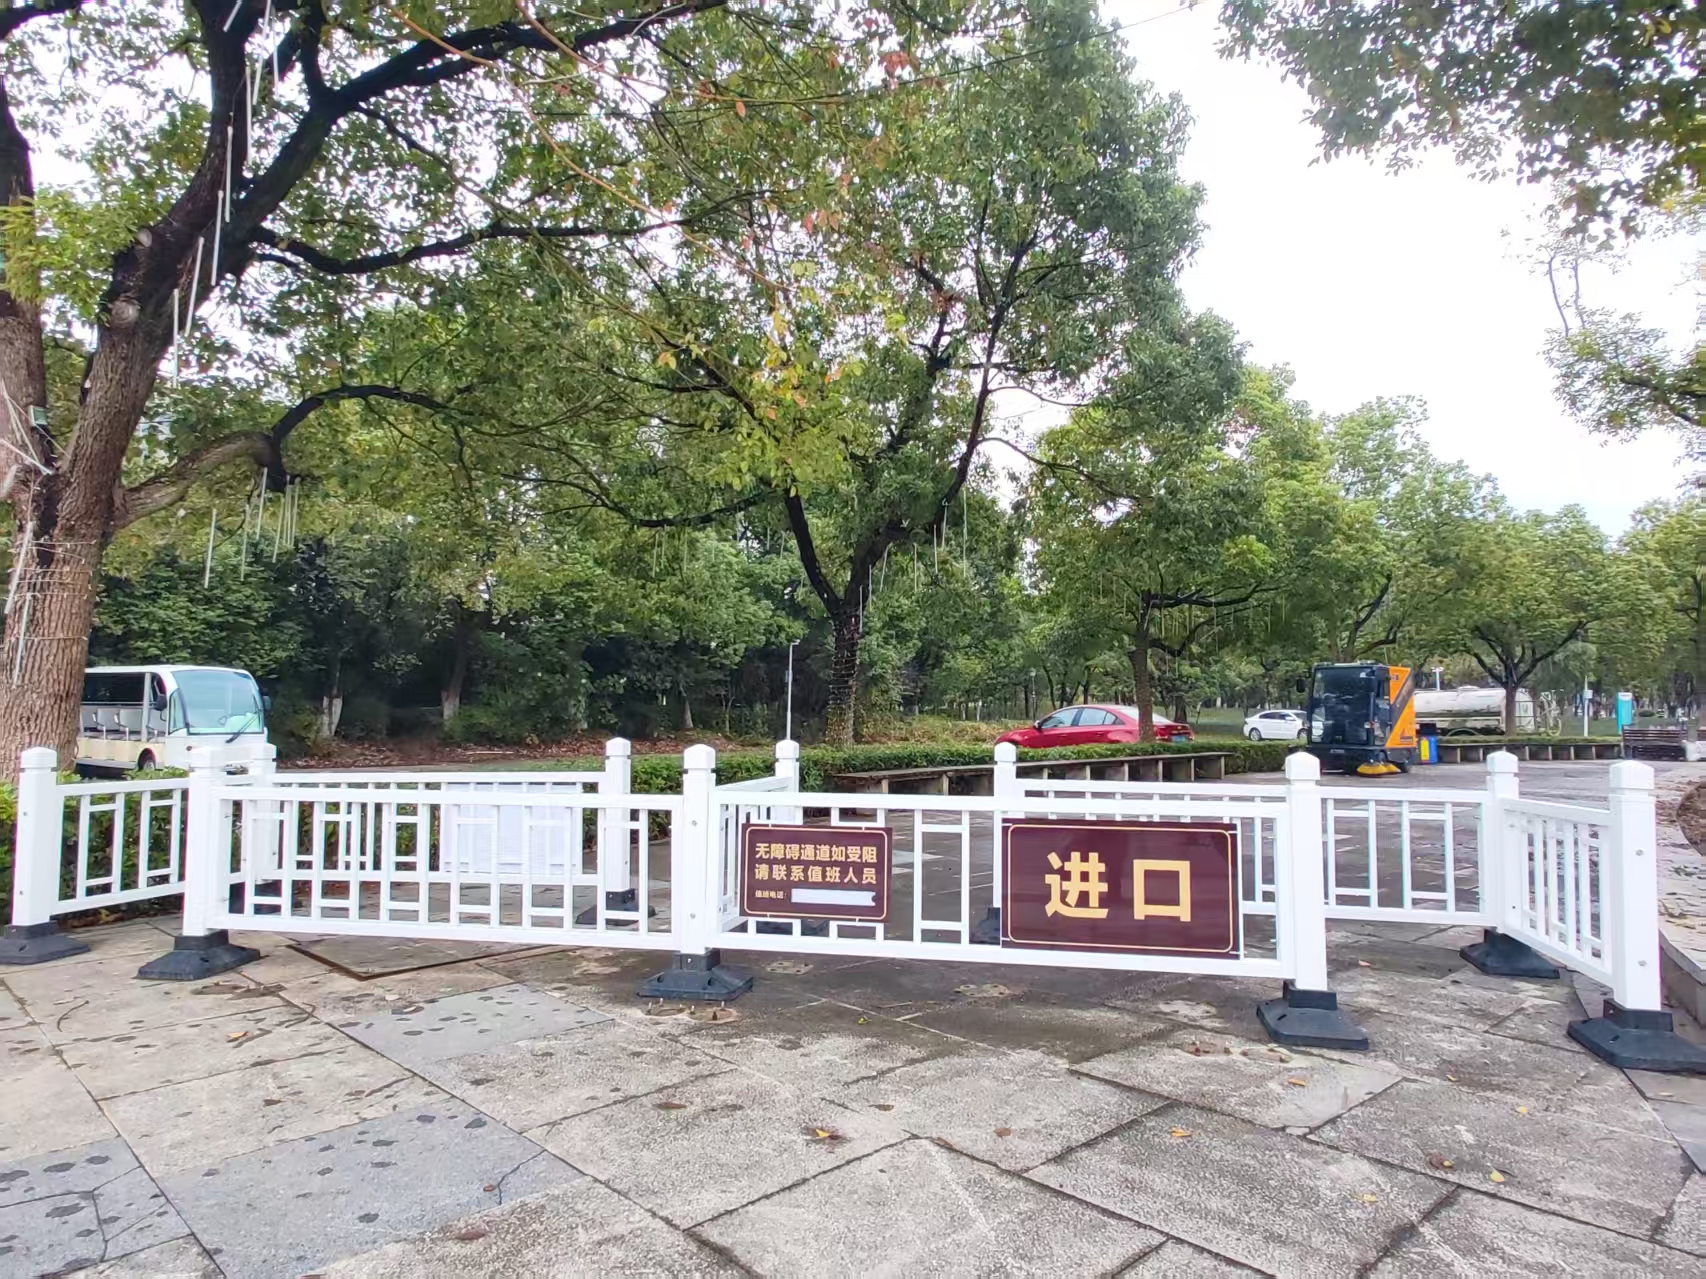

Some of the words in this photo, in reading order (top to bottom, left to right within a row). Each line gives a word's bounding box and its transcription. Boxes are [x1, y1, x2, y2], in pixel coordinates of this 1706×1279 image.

[755, 843, 877, 863] 无障碍通道如受阻
[754, 863, 877, 884] 请联系值班人员
[1045, 851, 1192, 922] 进口
